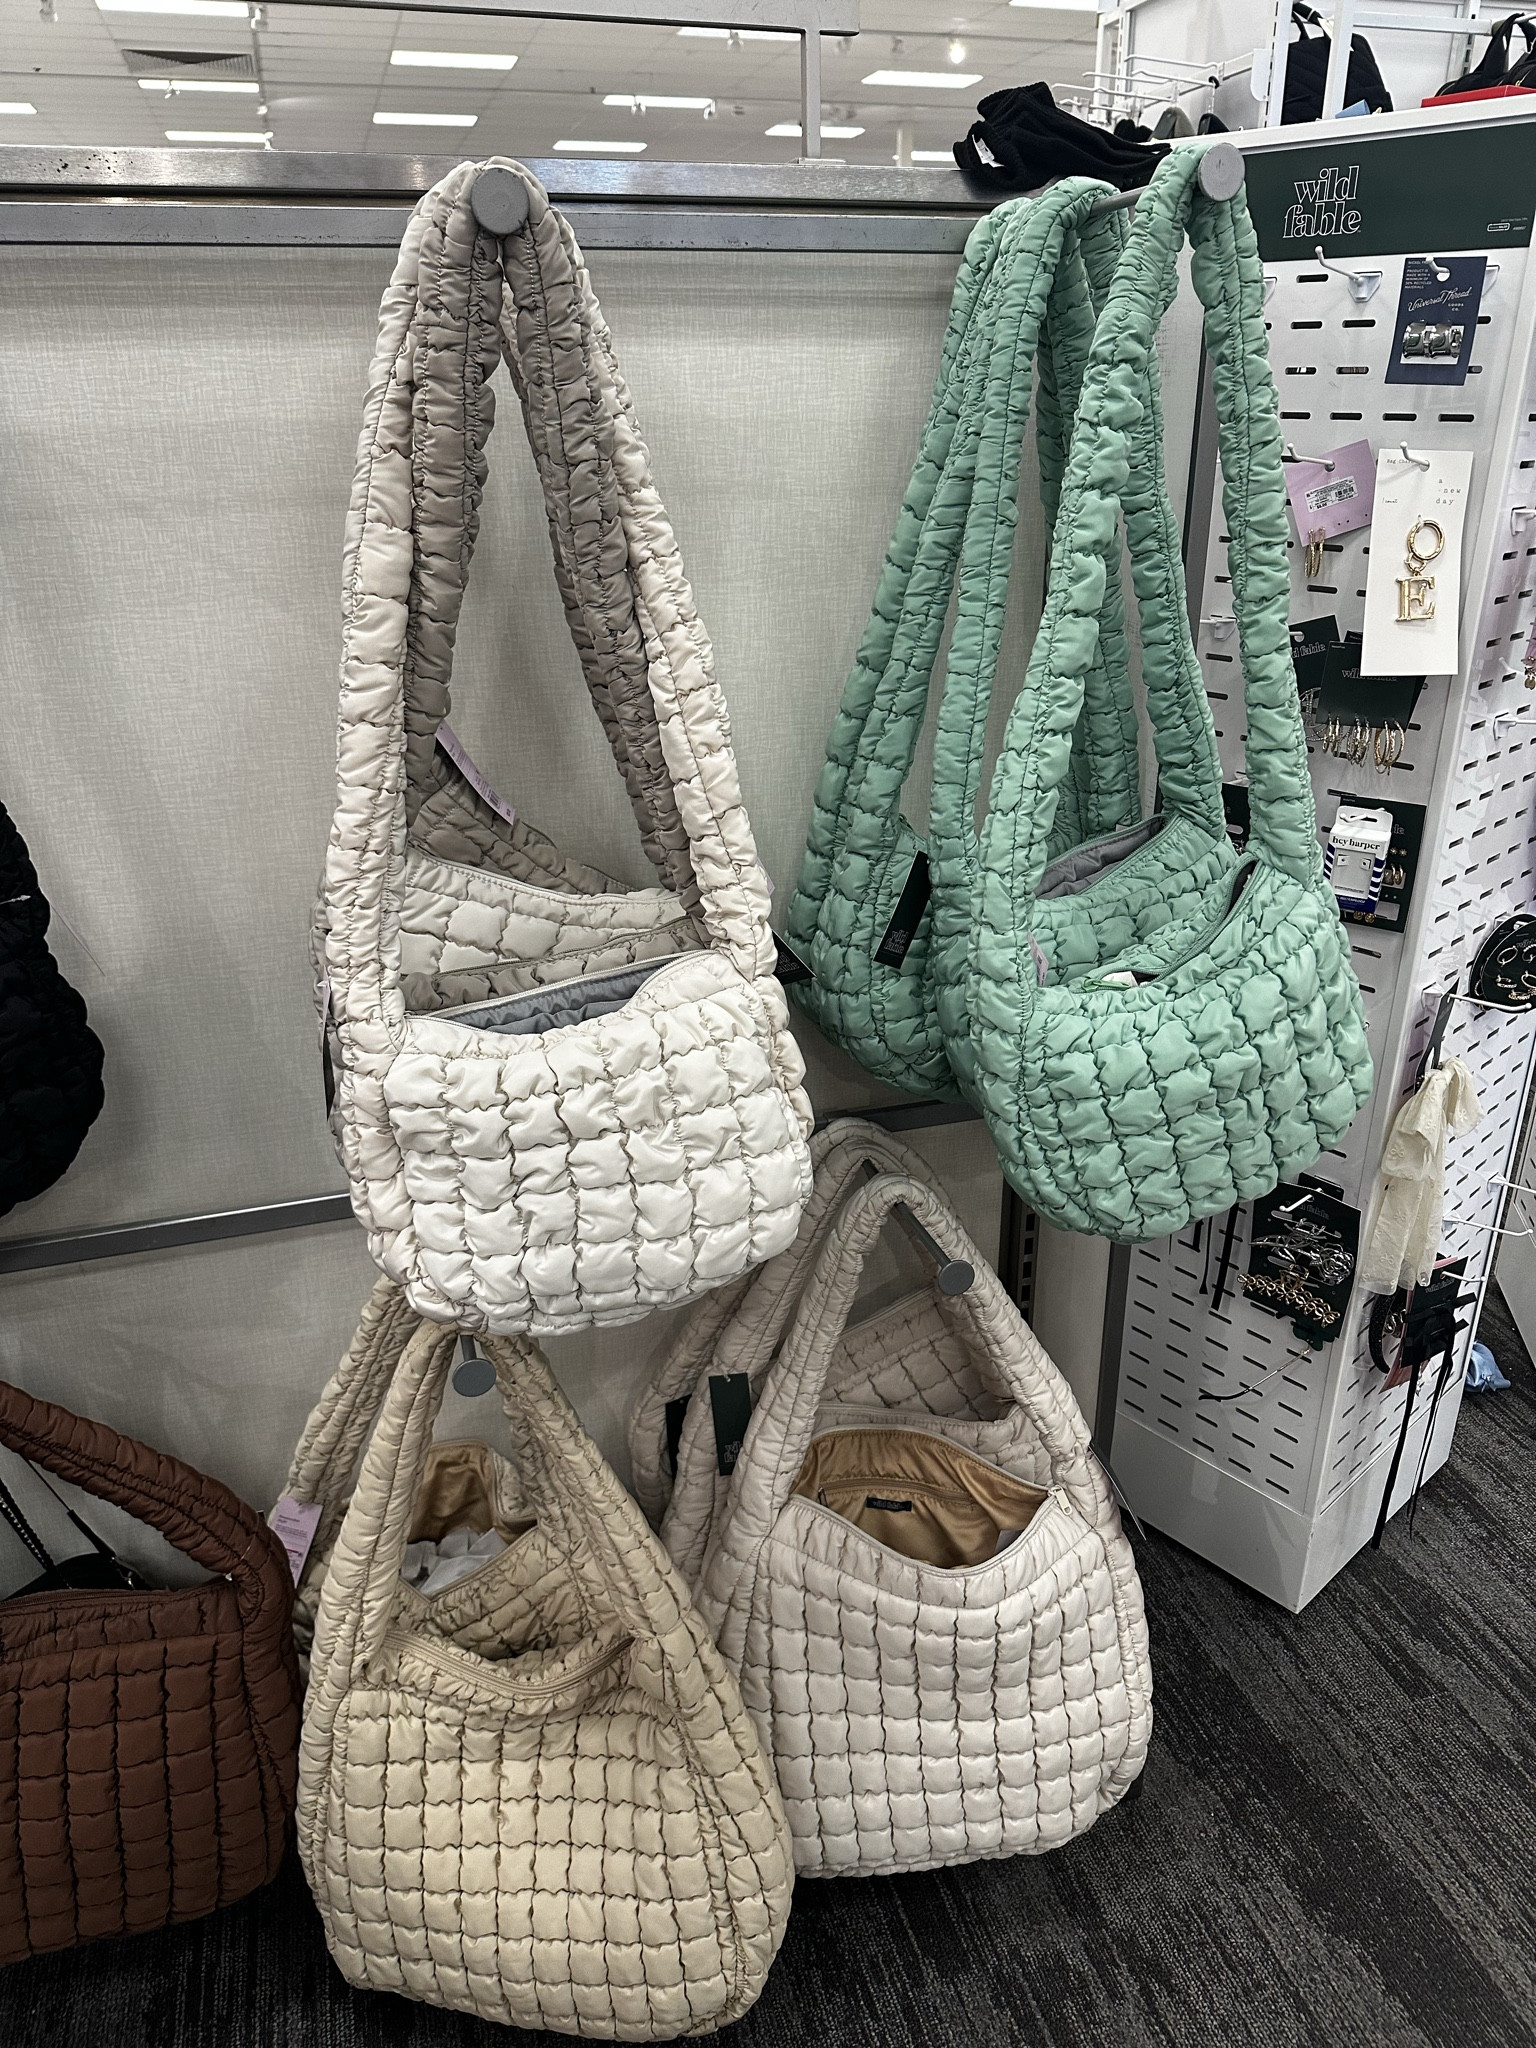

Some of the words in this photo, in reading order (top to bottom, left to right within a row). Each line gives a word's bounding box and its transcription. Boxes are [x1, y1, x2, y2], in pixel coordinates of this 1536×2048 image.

[1294, 165, 1359, 204] wild
[1283, 201, 1361, 239] fable
[1407, 292, 1446, 312] Universal
[1440, 286, 1473, 304] Thread
[1435, 497, 1455, 506] day
[1300, 641, 1326, 657] fable
[1341, 667, 1361, 679] wil
[1332, 835, 1349, 847] hey
[1348, 839, 1381, 850] harper
